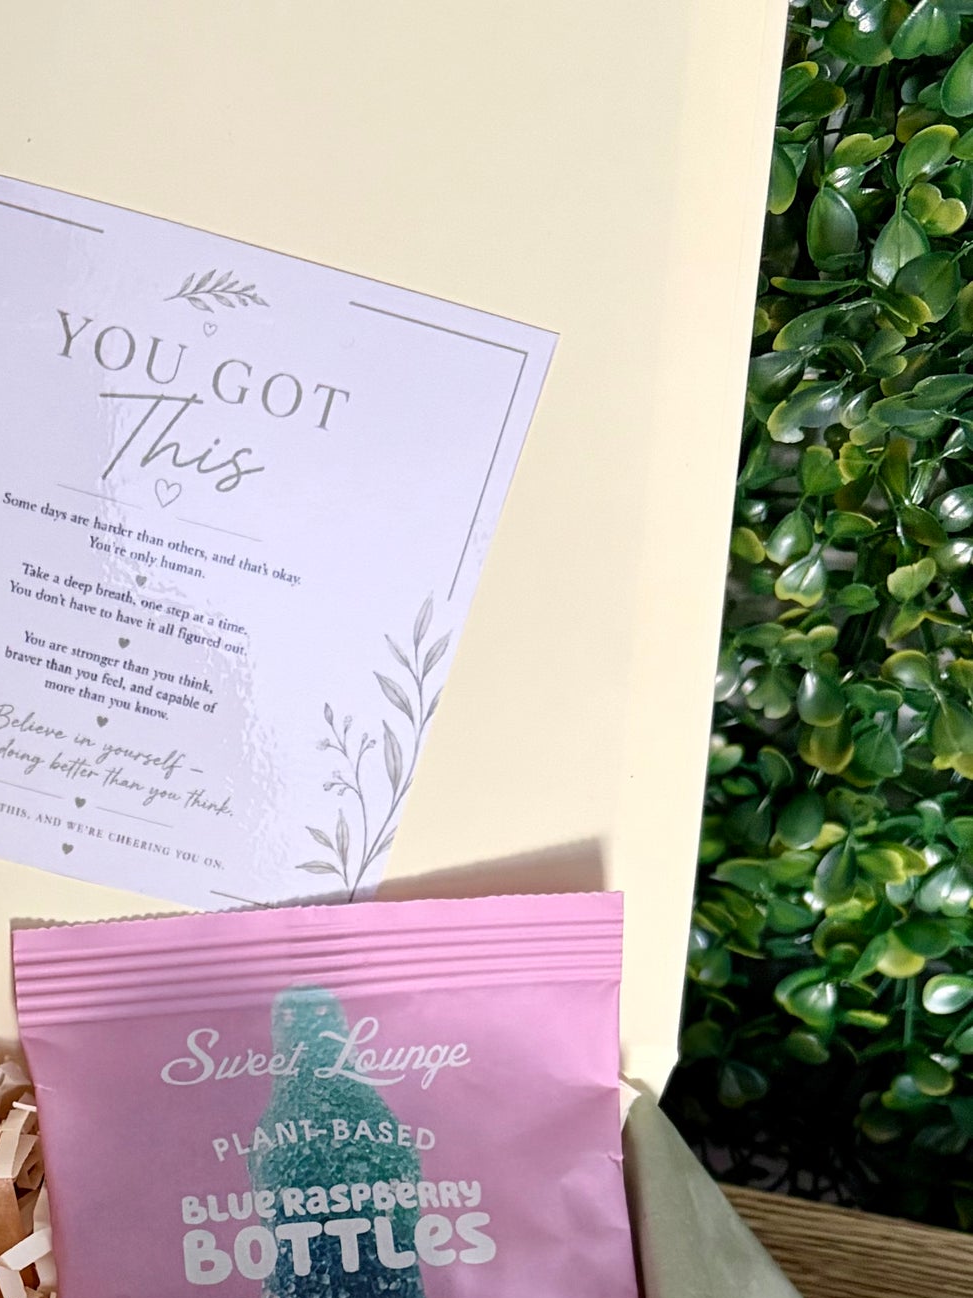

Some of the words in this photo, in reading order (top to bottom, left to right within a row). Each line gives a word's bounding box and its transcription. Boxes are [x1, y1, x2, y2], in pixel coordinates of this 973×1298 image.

[57, 309, 187, 384] YOU
[212, 359, 350, 431] GOT
[99, 393, 265, 492] This
[2, 492, 38, 512] Some
[40, 502, 68, 522] days
[70, 513, 90, 526] are
[93, 516, 133, 538] harder
[136, 529, 164, 547] than
[167, 540, 208, 560] others,
[212, 552, 236, 567] and
[238, 558, 268, 576] that's
[272, 568, 301, 587] okay.
[89, 535, 127, 557] You're
[129, 551, 157, 568] only
[160, 555, 205, 579] human.
[10, 579, 32, 597] You
[35, 588, 66, 607] don't
[69, 597, 97, 615] have
[100, 608, 113, 619] to
[115, 609, 143, 628] have
[147, 618, 156, 631] it
[158, 623, 175, 636] all
[177, 626, 222, 645] figured
[224, 642, 248, 657] out.
[22, 562, 50, 581] Take
[53, 575, 60, 584] a
[63, 576, 93, 595] deep
[141, 600, 163, 612] one
[166, 606, 190, 622] step
[192, 613, 205, 624] at
[207, 617, 215, 626] a
[218, 618, 248, 635] time.
[5, 645, 43, 667] braver
[45, 658, 72, 675] than
[75, 668, 98, 681] you
[130, 685, 153, 697] and
[155, 693, 200, 710] capable
[202, 702, 218, 714] of
[25, 630, 46, 647] You
[48, 641, 68, 654] are
[70, 647, 121, 668] stronger
[122, 658, 149, 676] than
[152, 669, 175, 683] you
[178, 674, 214, 694] think,
[44, 679, 76, 695] more
[78, 687, 105, 703] than
[107, 697, 131, 710] you
[134, 700, 169, 721] know.
[49, 752, 99, 780] better
[102, 767, 145, 787] than
[142, 786, 181, 807] you
[183, 789, 233, 817] think.
[74, 732, 96, 747] in
[95, 743, 186, 780] yourself
[35, 813, 62, 827] AND
[67, 820, 104, 838] WE'RE
[108, 831, 170, 856] CHEERING
[175, 849, 200, 863] YOU
[203, 857, 225, 870] ON.
[160, 1028, 309, 1086] Sweet
[314, 1016, 471, 1090] Lounge
[212, 1118, 436, 1162] PLANT-BASED
